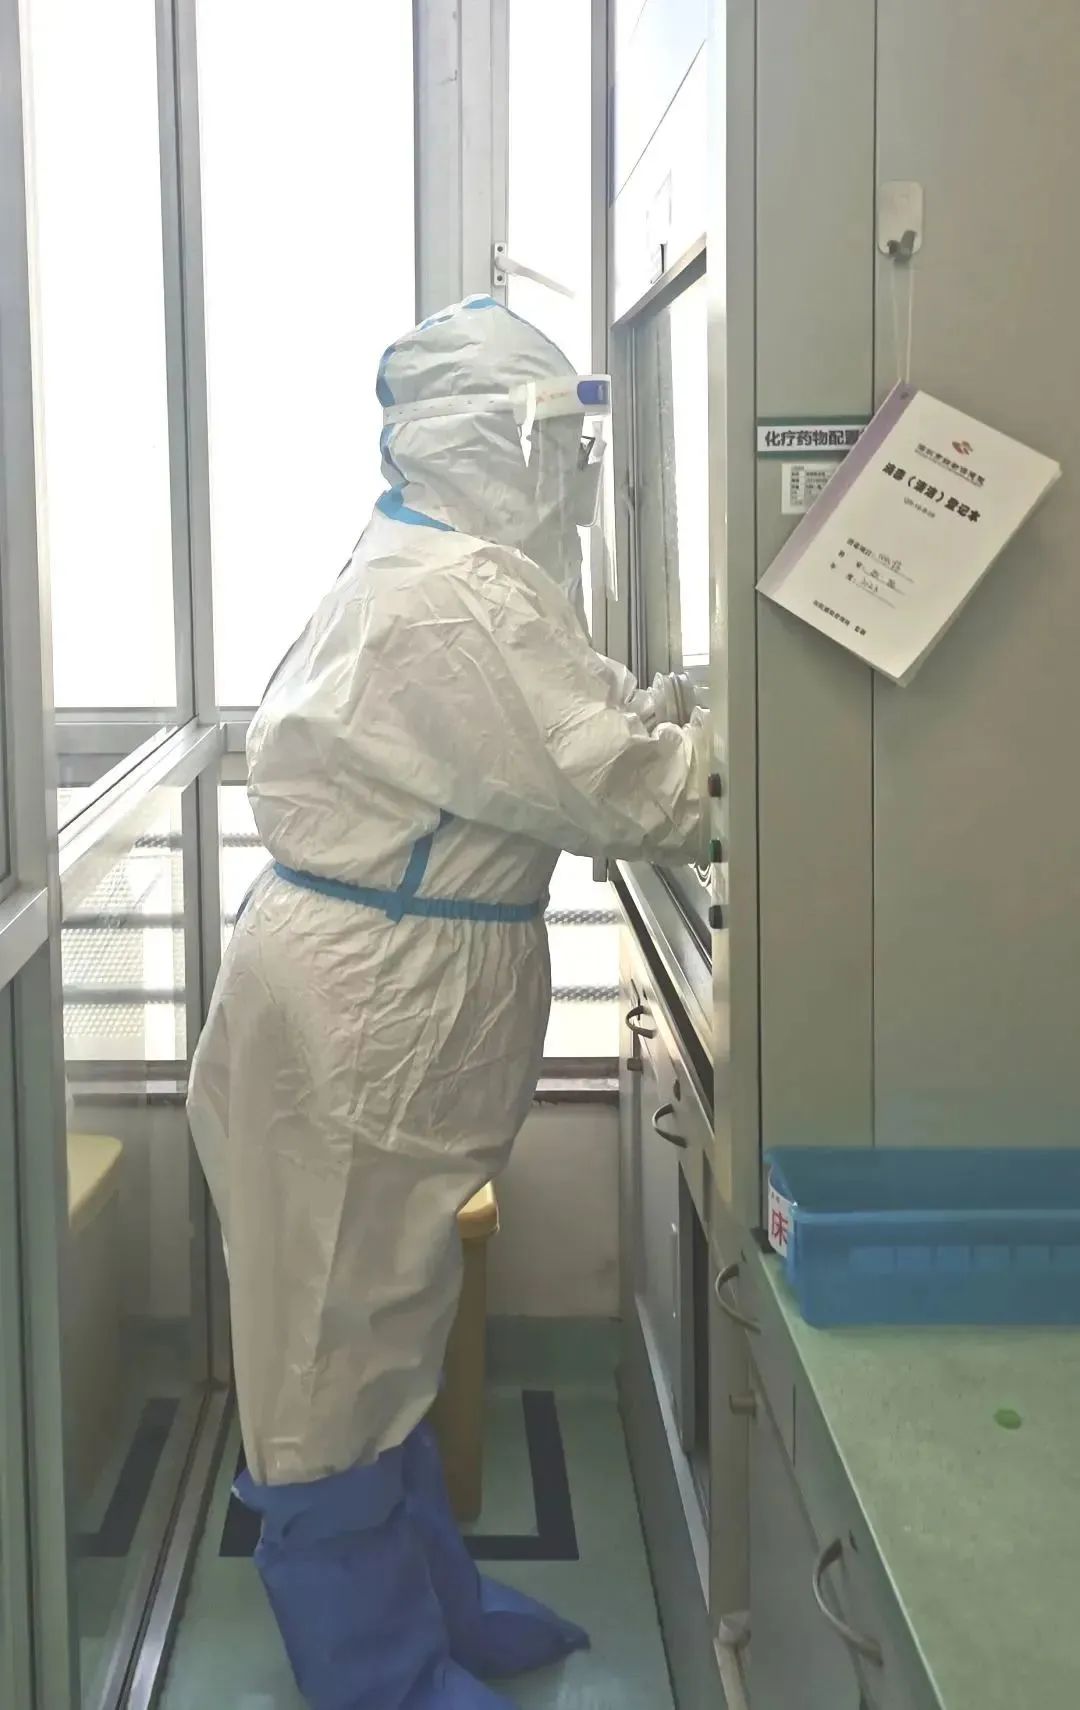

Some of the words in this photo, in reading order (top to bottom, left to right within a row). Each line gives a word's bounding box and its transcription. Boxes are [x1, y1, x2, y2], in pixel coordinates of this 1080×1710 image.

[764, 429, 864, 447] 化疗药物配置
